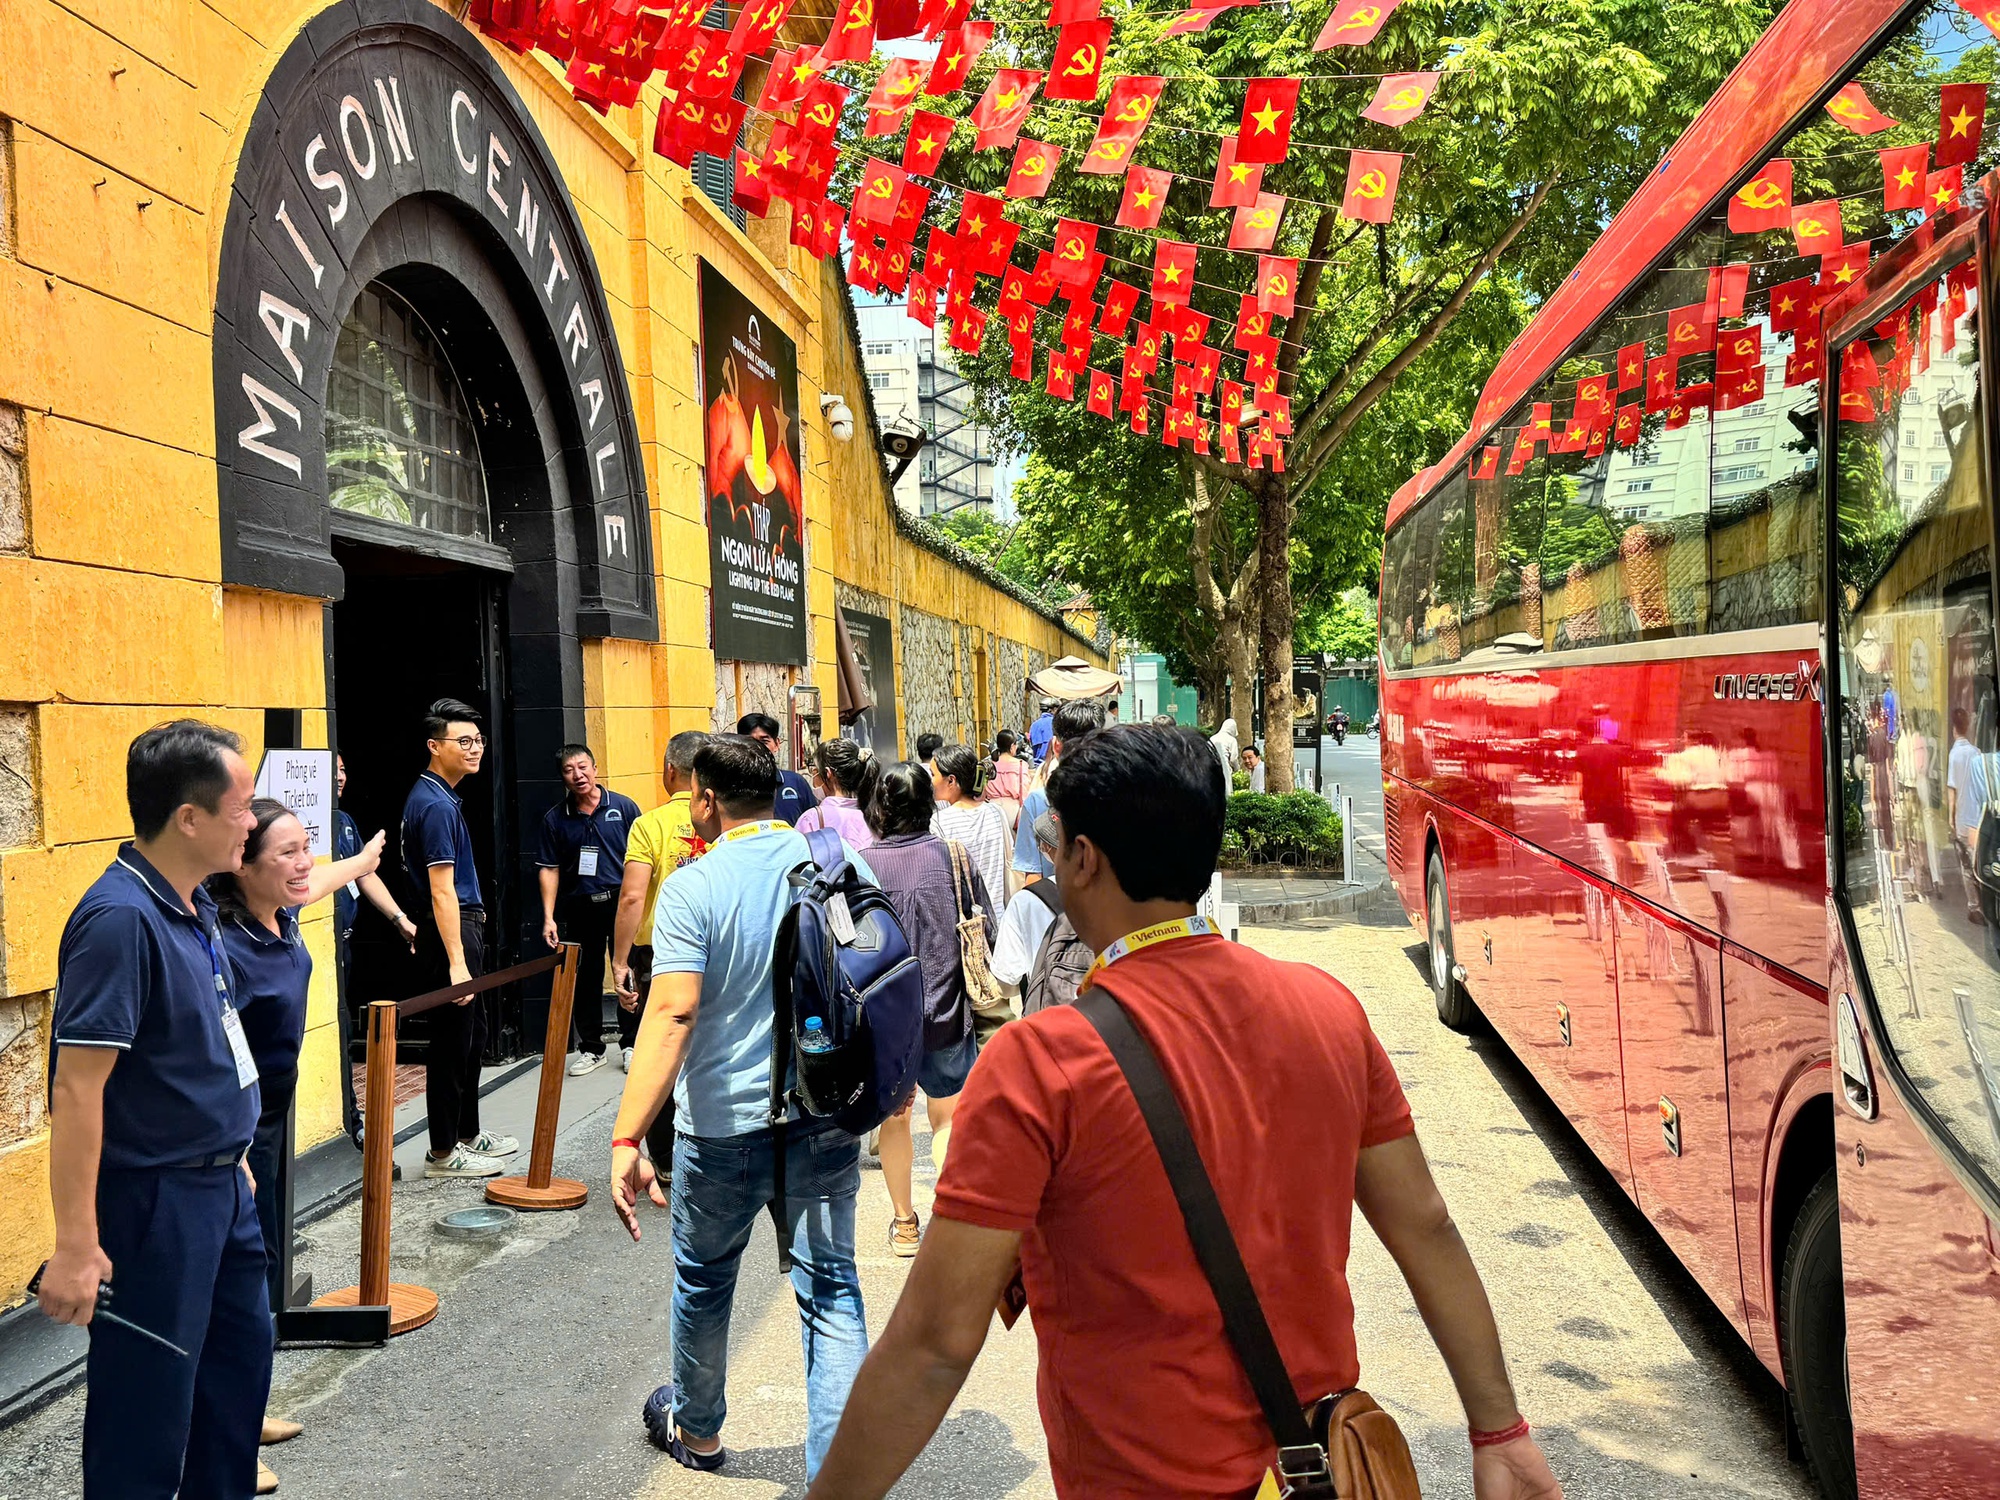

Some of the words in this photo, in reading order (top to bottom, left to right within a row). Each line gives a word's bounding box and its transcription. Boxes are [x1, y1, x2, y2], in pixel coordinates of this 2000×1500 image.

[238, 76, 415, 481] MAISON
[450, 90, 628, 559] CENTRALE
[721, 535, 753, 571] NGỌN
[728, 570, 753, 591] LIGHTING
[753, 577, 761, 593] UP
[761, 579, 770, 596] THE
[780, 584, 795, 602] FLAME
[285, 760, 308, 783] Phòng
[309, 759, 317, 779] vé
[283, 788, 305, 809] Ticket
[306, 788, 319, 807] box
[1132, 925, 1181, 943] Vietnam
